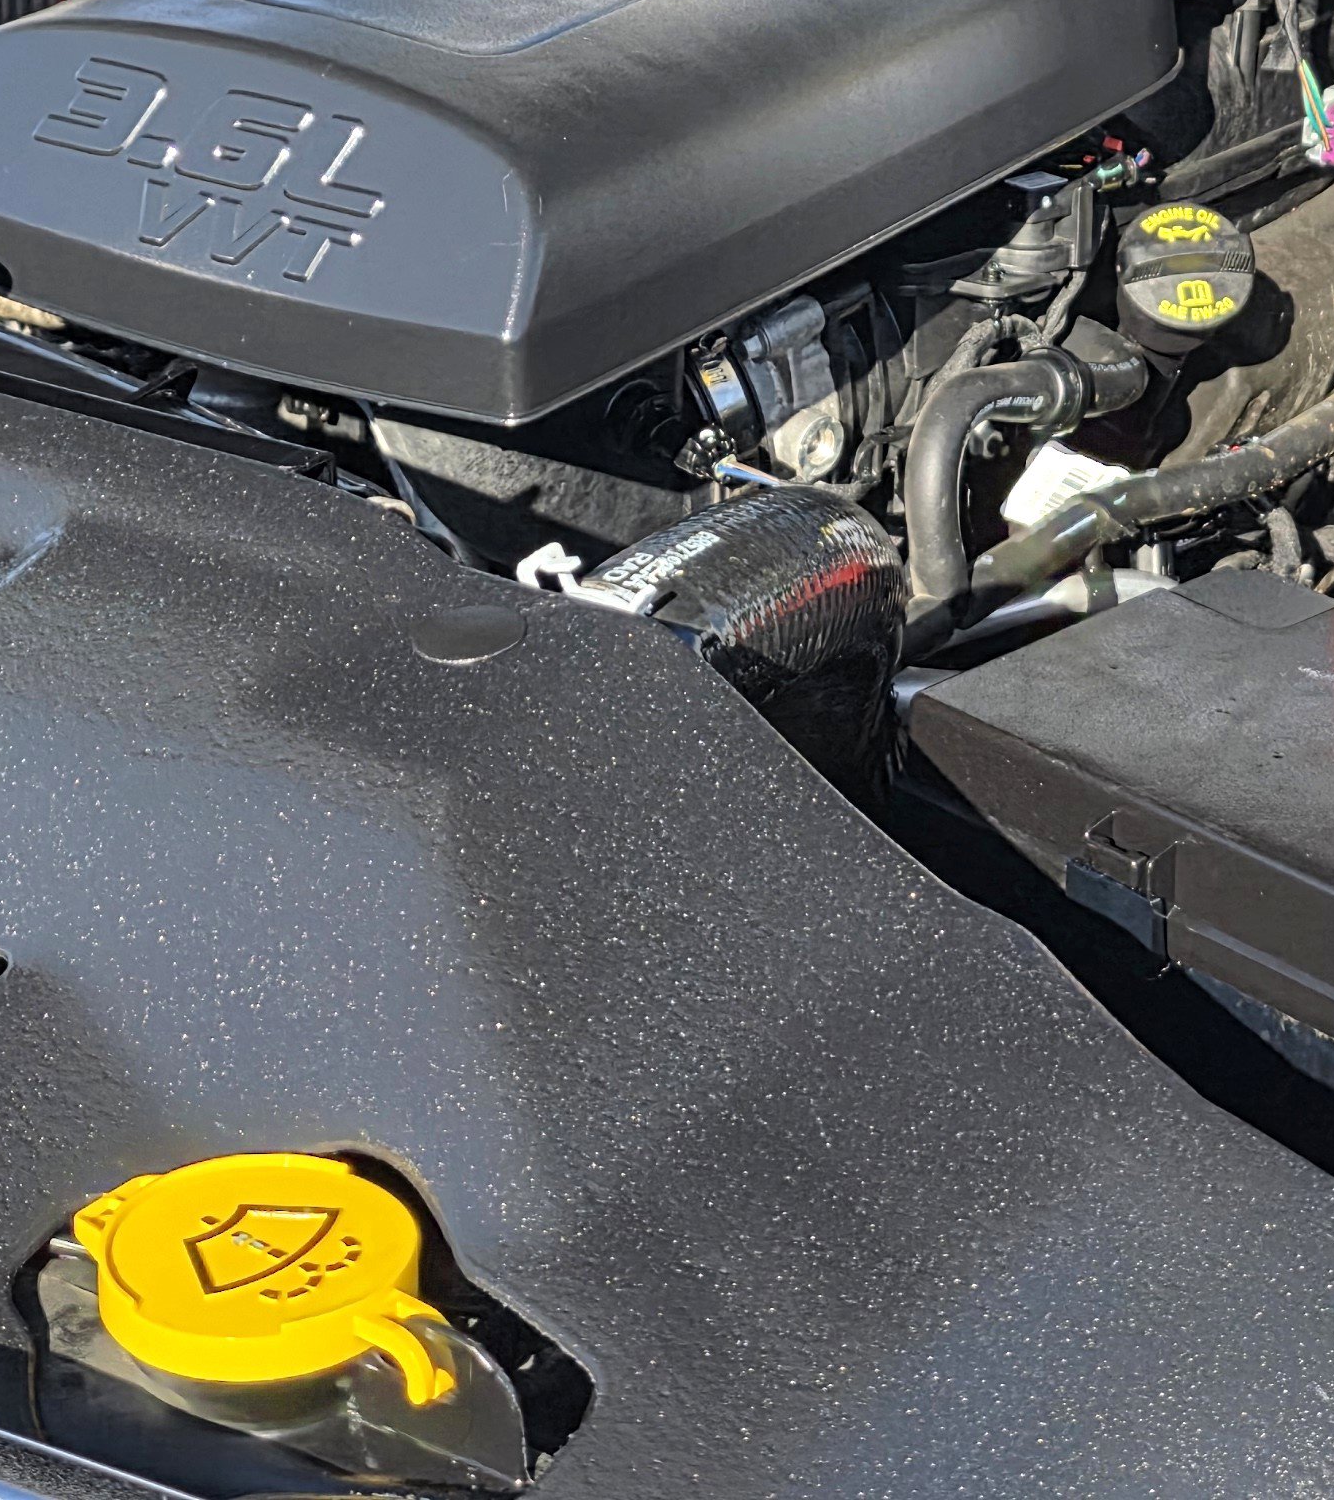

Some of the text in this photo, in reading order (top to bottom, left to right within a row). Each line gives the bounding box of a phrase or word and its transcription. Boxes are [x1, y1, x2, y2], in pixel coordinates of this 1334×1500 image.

[33, 57, 386, 219] 3.6L
[137, 178, 363, 283] VVT
[1140, 206, 1221, 234] ENGINE OIL
[1158, 299, 1188, 321] SAE
